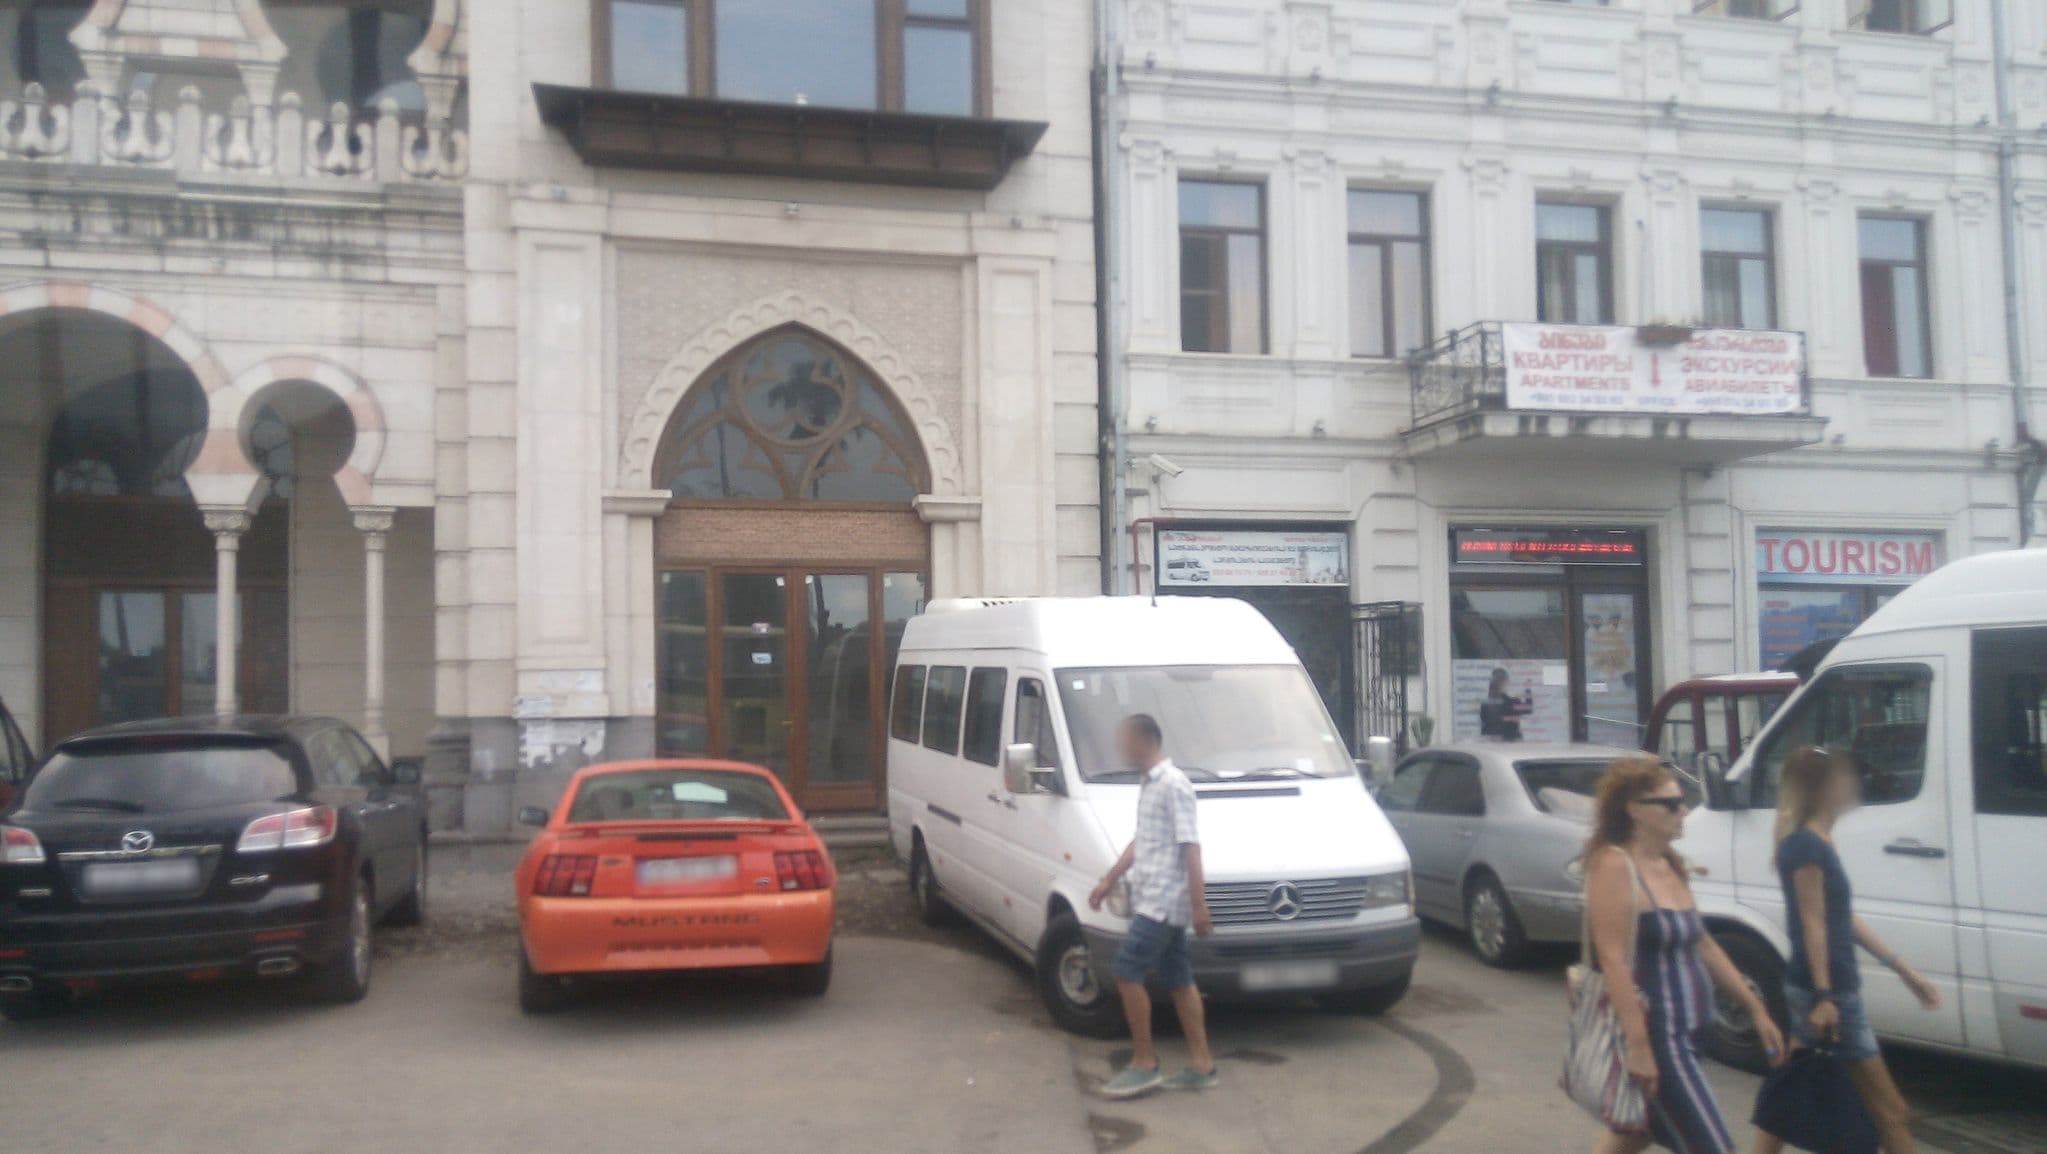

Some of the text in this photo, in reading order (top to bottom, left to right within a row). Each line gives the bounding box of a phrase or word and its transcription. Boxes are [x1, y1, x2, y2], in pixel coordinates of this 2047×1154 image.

[1513, 352, 1632, 372] КВАРТИРЫ
[1680, 355, 1798, 375] ЭКСКУРСИИ
[1520, 375, 1631, 391] APARTMENTS
[1758, 538, 1933, 574] TOURISM
[611, 911, 762, 929] MUSTANG
